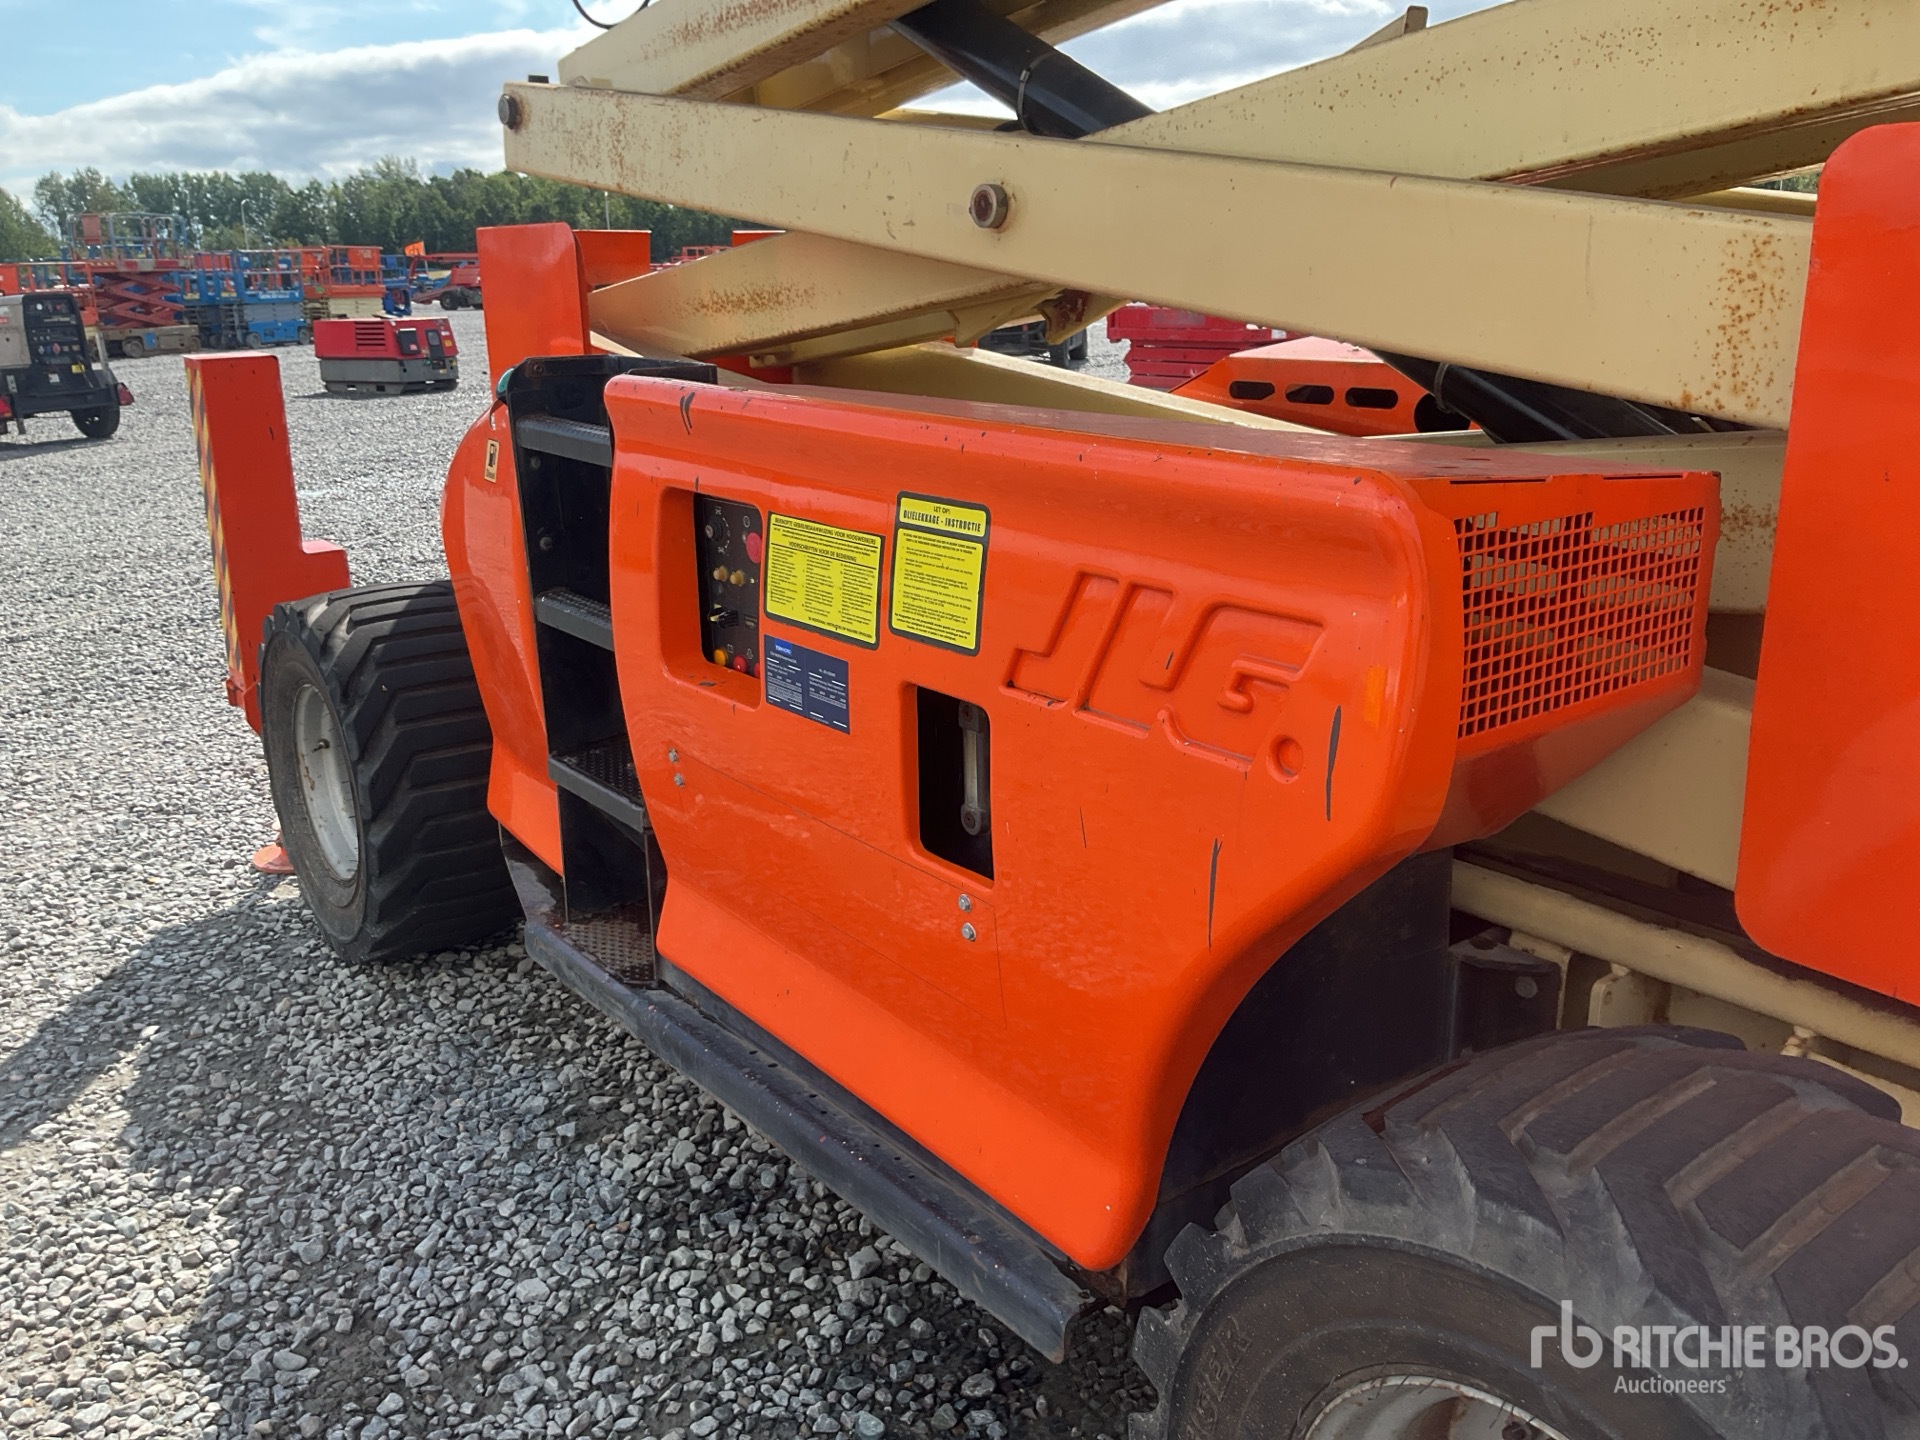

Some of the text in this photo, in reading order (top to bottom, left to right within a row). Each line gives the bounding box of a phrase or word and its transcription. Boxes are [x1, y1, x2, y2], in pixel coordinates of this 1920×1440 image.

[903, 509, 940, 525] OLIELEKKAGE
[945, 517, 982, 532] INSTRUCTIE
[834, 530, 846, 538] VOOR
[788, 541, 818, 553] VOORSCHRIFTEN
[819, 548, 830, 556] VOOR
[835, 551, 857, 562] BEDIENING
